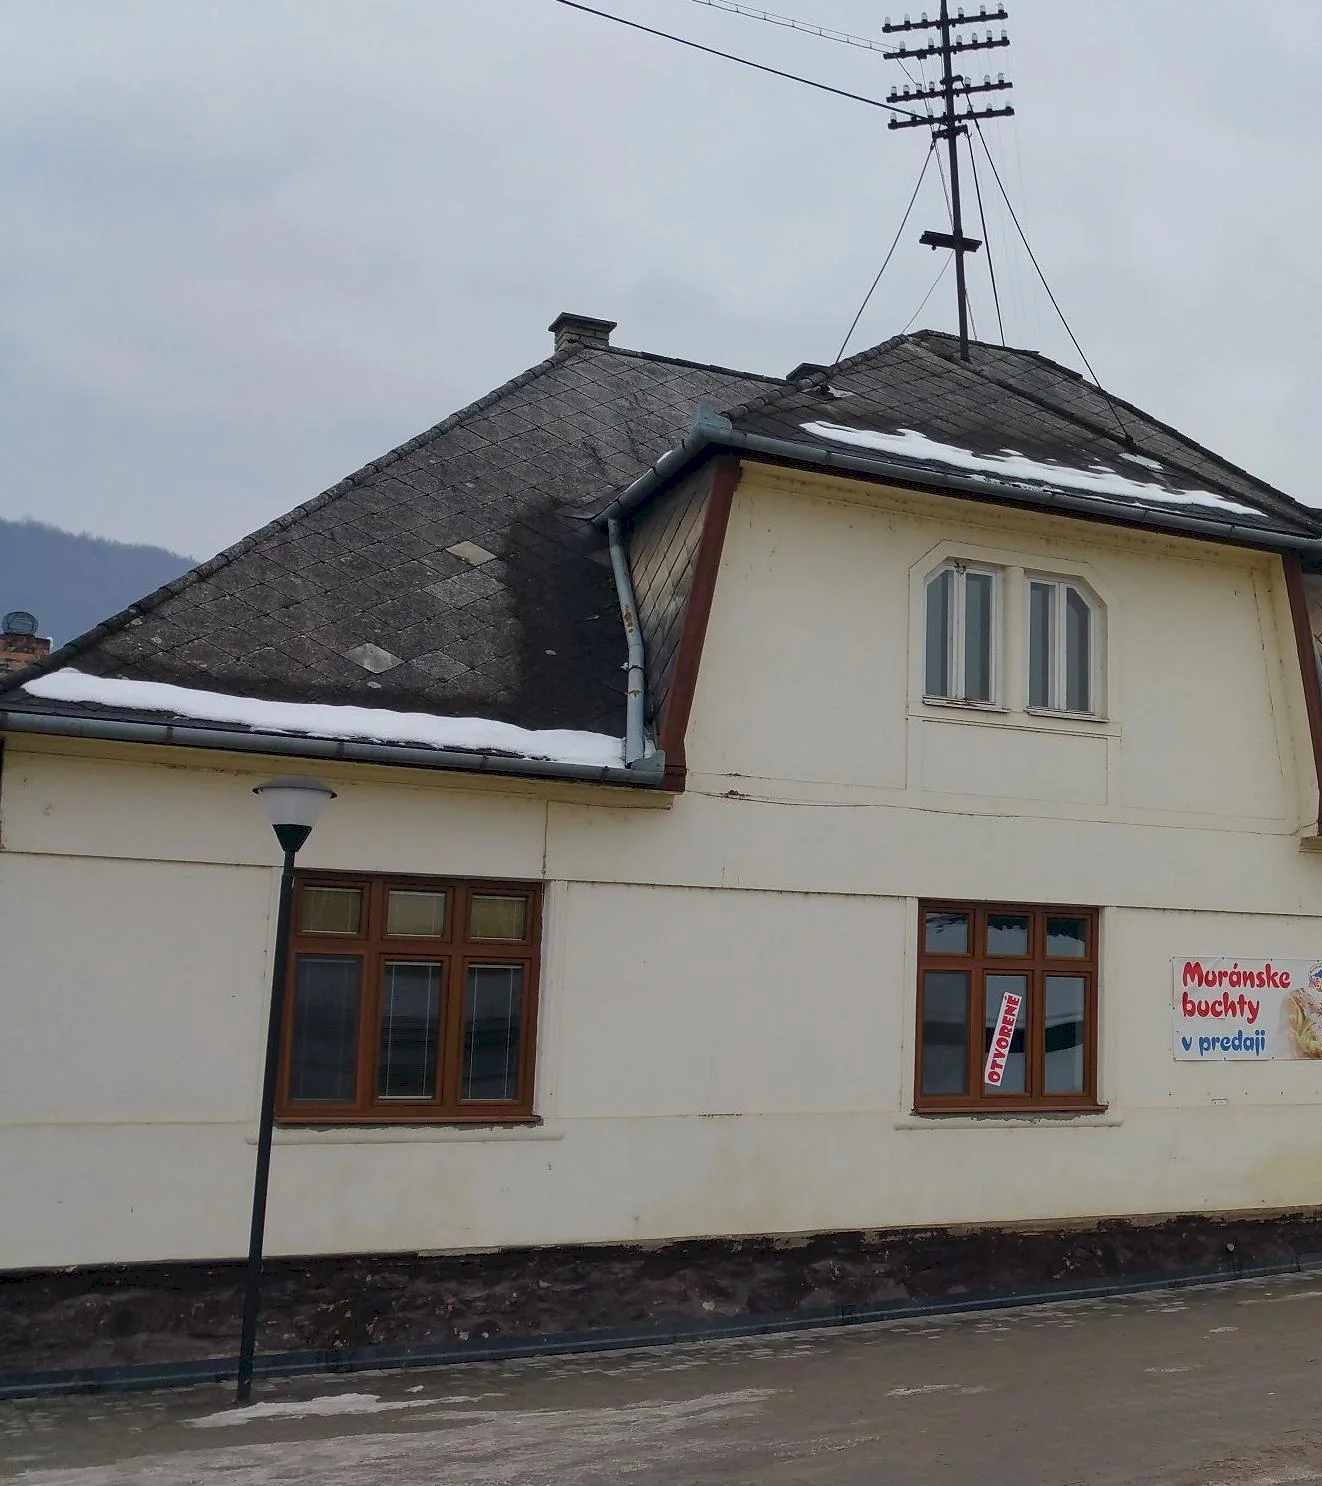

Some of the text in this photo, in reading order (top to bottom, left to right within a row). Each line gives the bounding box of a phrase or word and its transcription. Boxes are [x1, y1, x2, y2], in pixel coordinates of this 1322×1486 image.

[1183, 962, 1291, 989] Muránske
[1181, 991, 1260, 1024] buchty
[988, 995, 1020, 1083] OTVORENÉ
[1181, 1029, 1267, 1056] v predaji
